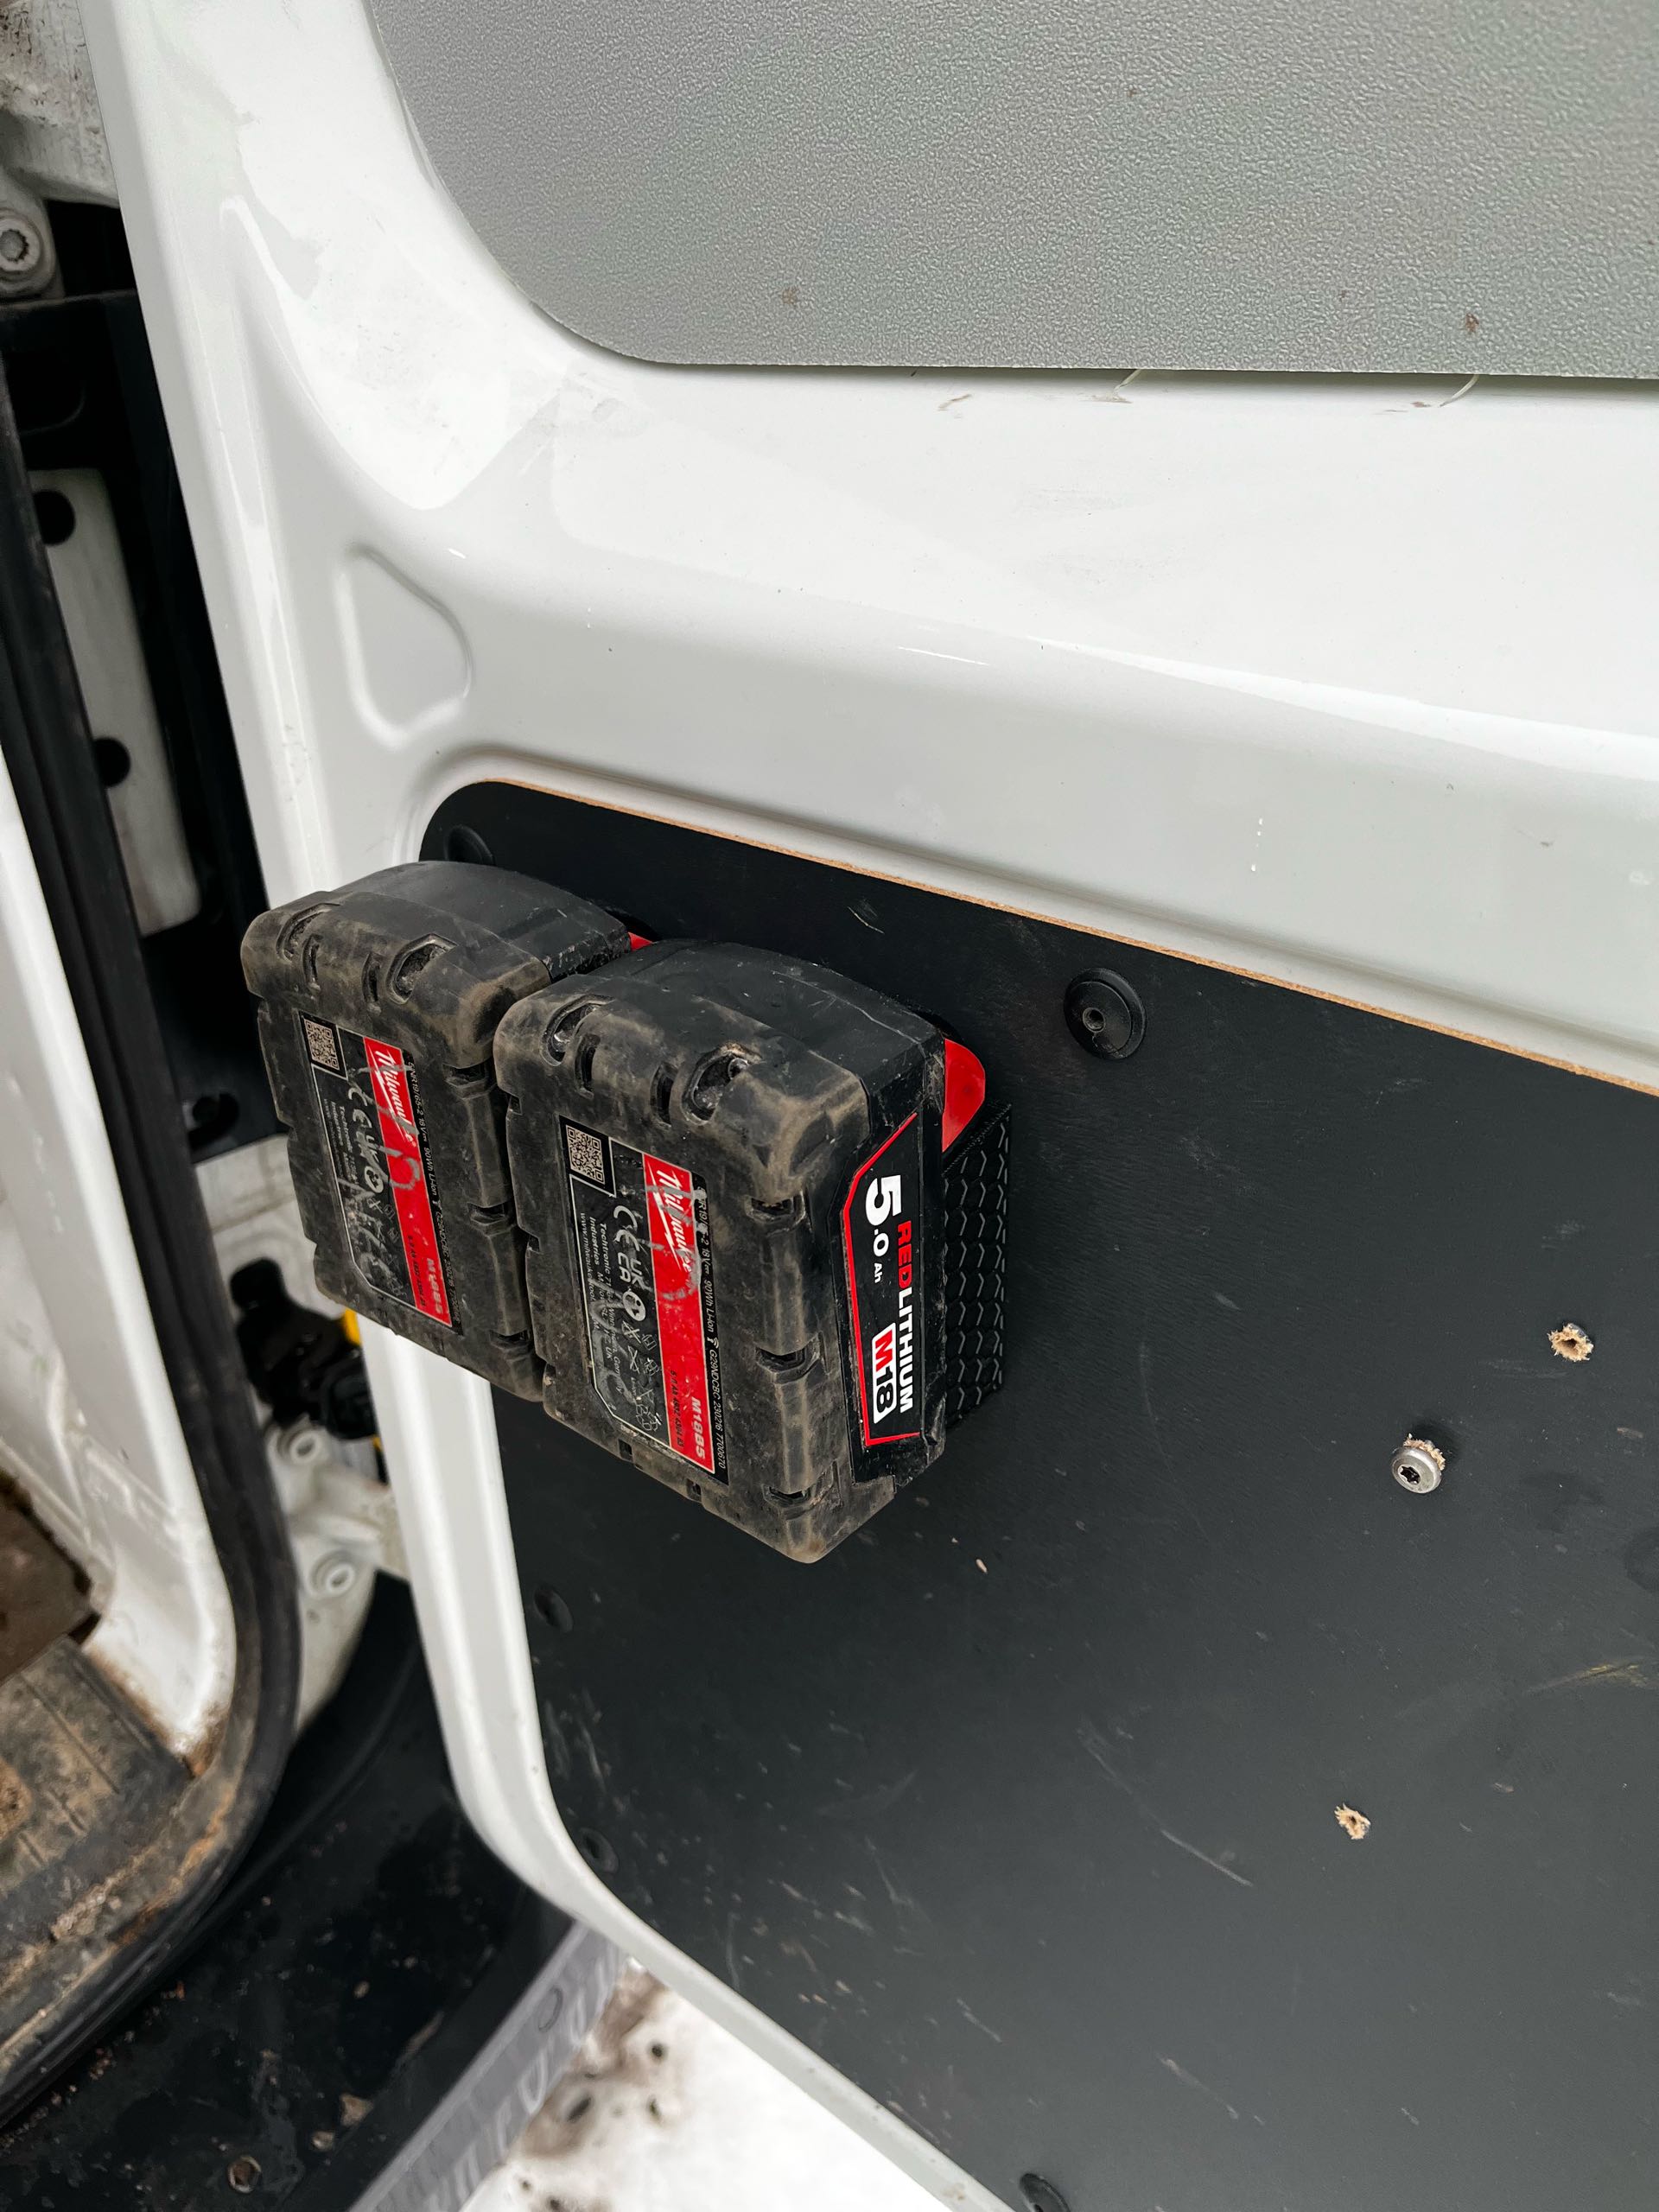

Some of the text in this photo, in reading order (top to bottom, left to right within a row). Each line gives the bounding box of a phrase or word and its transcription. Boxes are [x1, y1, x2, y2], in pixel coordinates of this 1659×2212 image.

[407, 1061, 423, 1116] 5NR19/65-2
[423, 1147, 434, 1172] 90Wh
[589, 1216, 601, 1266] Industries
[600, 1223, 612, 1277] Techtronic
[613, 1205, 640, 1252] CE
[866, 1175, 901, 1284] 5.0 Ah
[426, 1258, 443, 1314] M18B5
[618, 1252, 632, 1283] CA
[628, 1257, 643, 1289] UK
[703, 1280, 714, 1306] 90Wh
[897, 1221, 913, 1414] REDLITHIUM
[709, 1349, 721, 1401] G29NDCBC
[874, 1329, 894, 1414] M18
[690, 1396, 706, 1460] M18B5
[712, 1400, 722, 1432] 230216
[715, 1432, 726, 1469] 7700670
